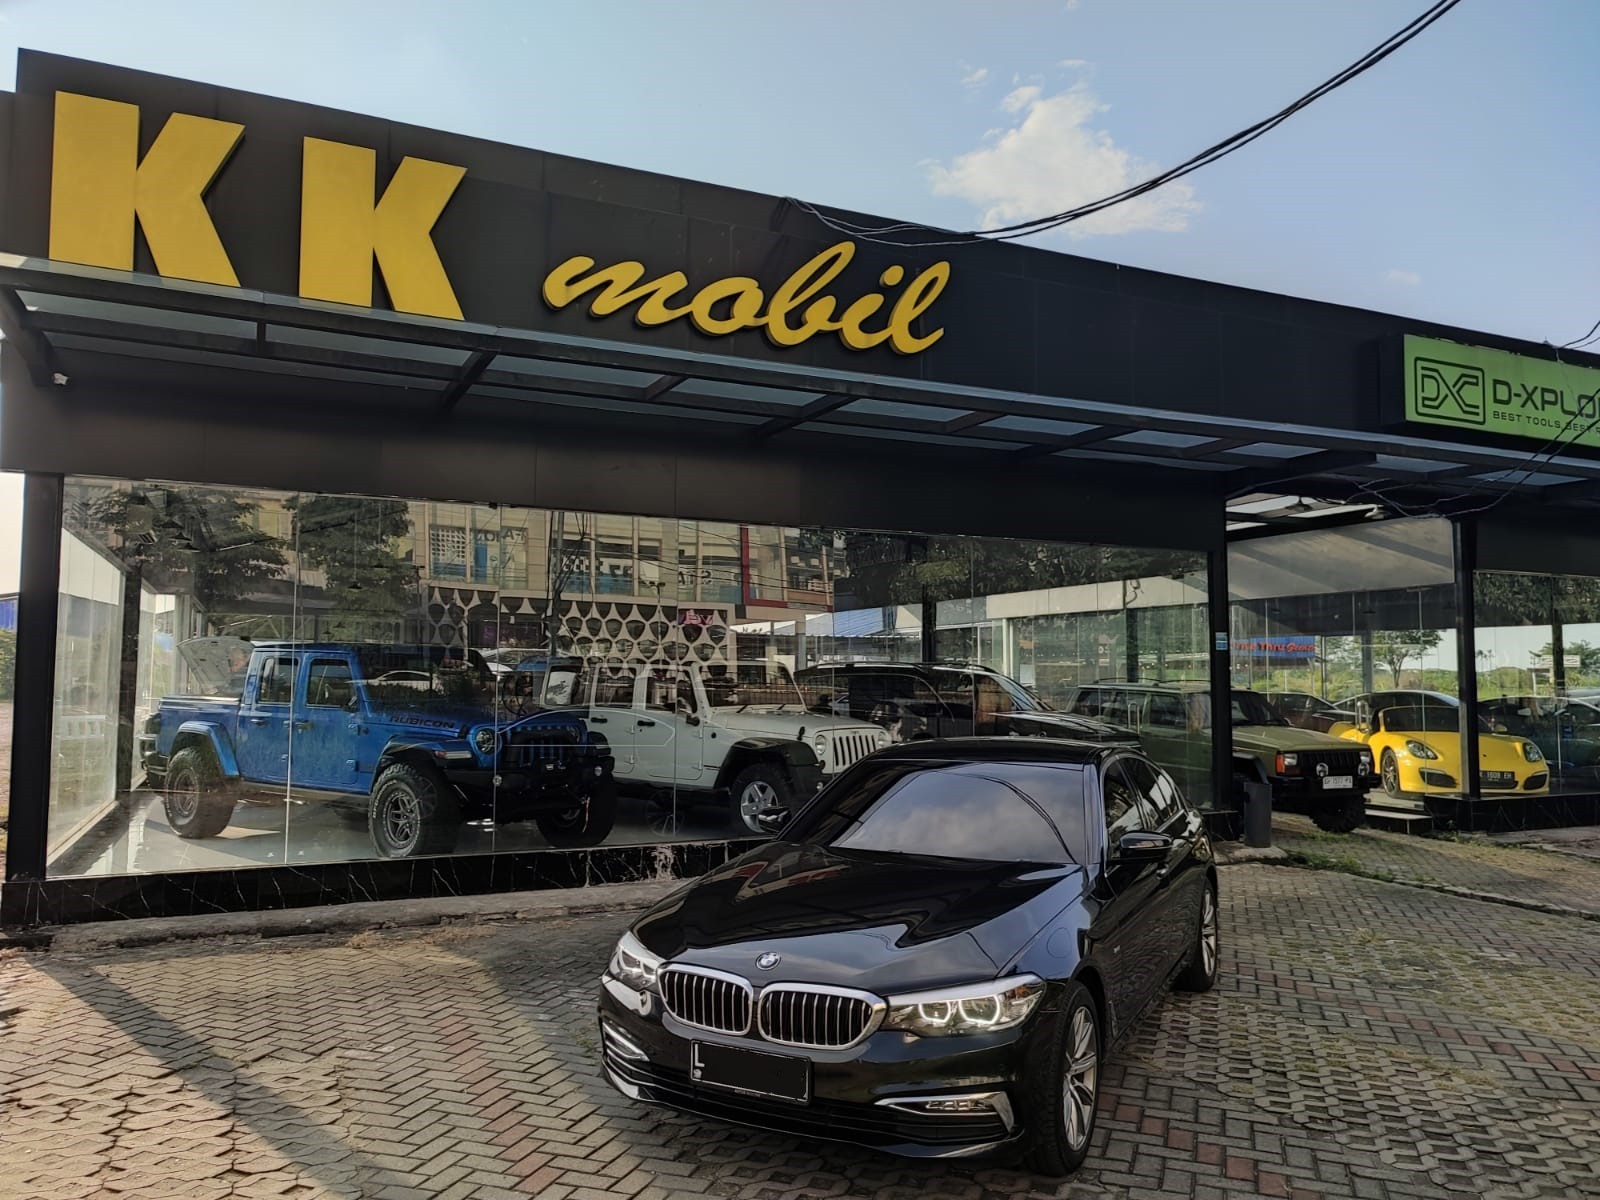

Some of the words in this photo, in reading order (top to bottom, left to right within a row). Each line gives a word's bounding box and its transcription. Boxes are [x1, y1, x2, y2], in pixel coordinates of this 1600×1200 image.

[541, 241, 952, 356] mobil
[1492, 378, 1600, 419] D-XPLO
[1493, 410, 1523, 422] BEST
[389, 715, 455, 729] RUBICON
